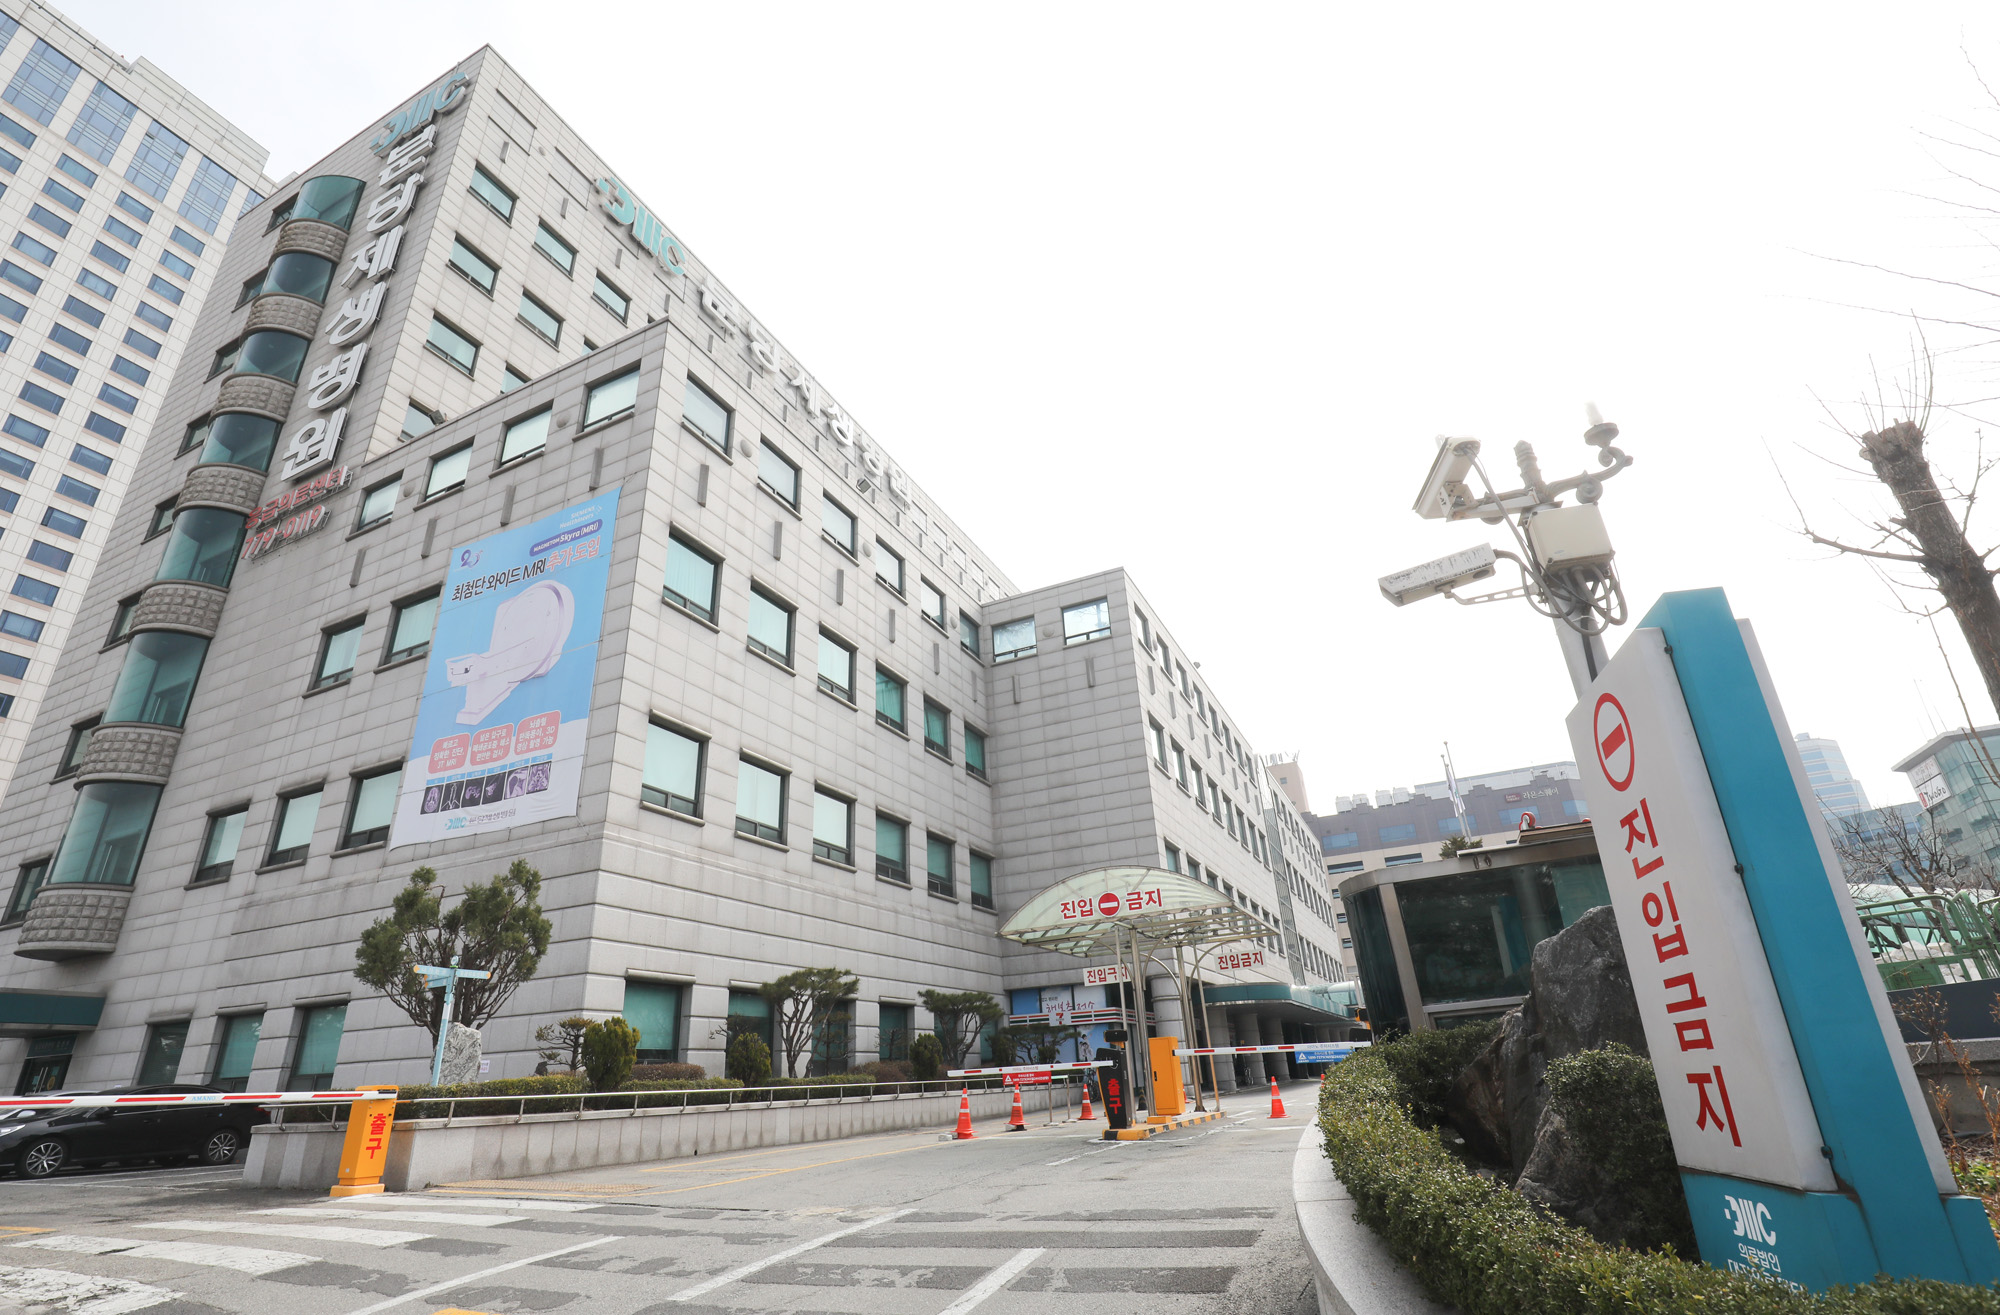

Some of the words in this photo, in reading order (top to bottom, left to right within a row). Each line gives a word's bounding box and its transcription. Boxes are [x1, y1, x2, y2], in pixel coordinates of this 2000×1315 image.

[281, 124, 437, 481] 분당제생병원
[700, 274, 912, 505] 분당제생병원
[246, 465, 348, 529] 응급의료센터
[241, 504, 325, 559] 779-0119
[560, 531, 580, 543] Skyra
[522, 558, 546, 580] MRI
[1060, 897, 1094, 920] 진입
[1125, 888, 1163, 912] 금지
[1217, 949, 1264, 972] 진입금지
[1619, 797, 1742, 1148] 진입금지
[1108, 1078, 1122, 1114] 출구
[366, 1113, 387, 1159] 출구
